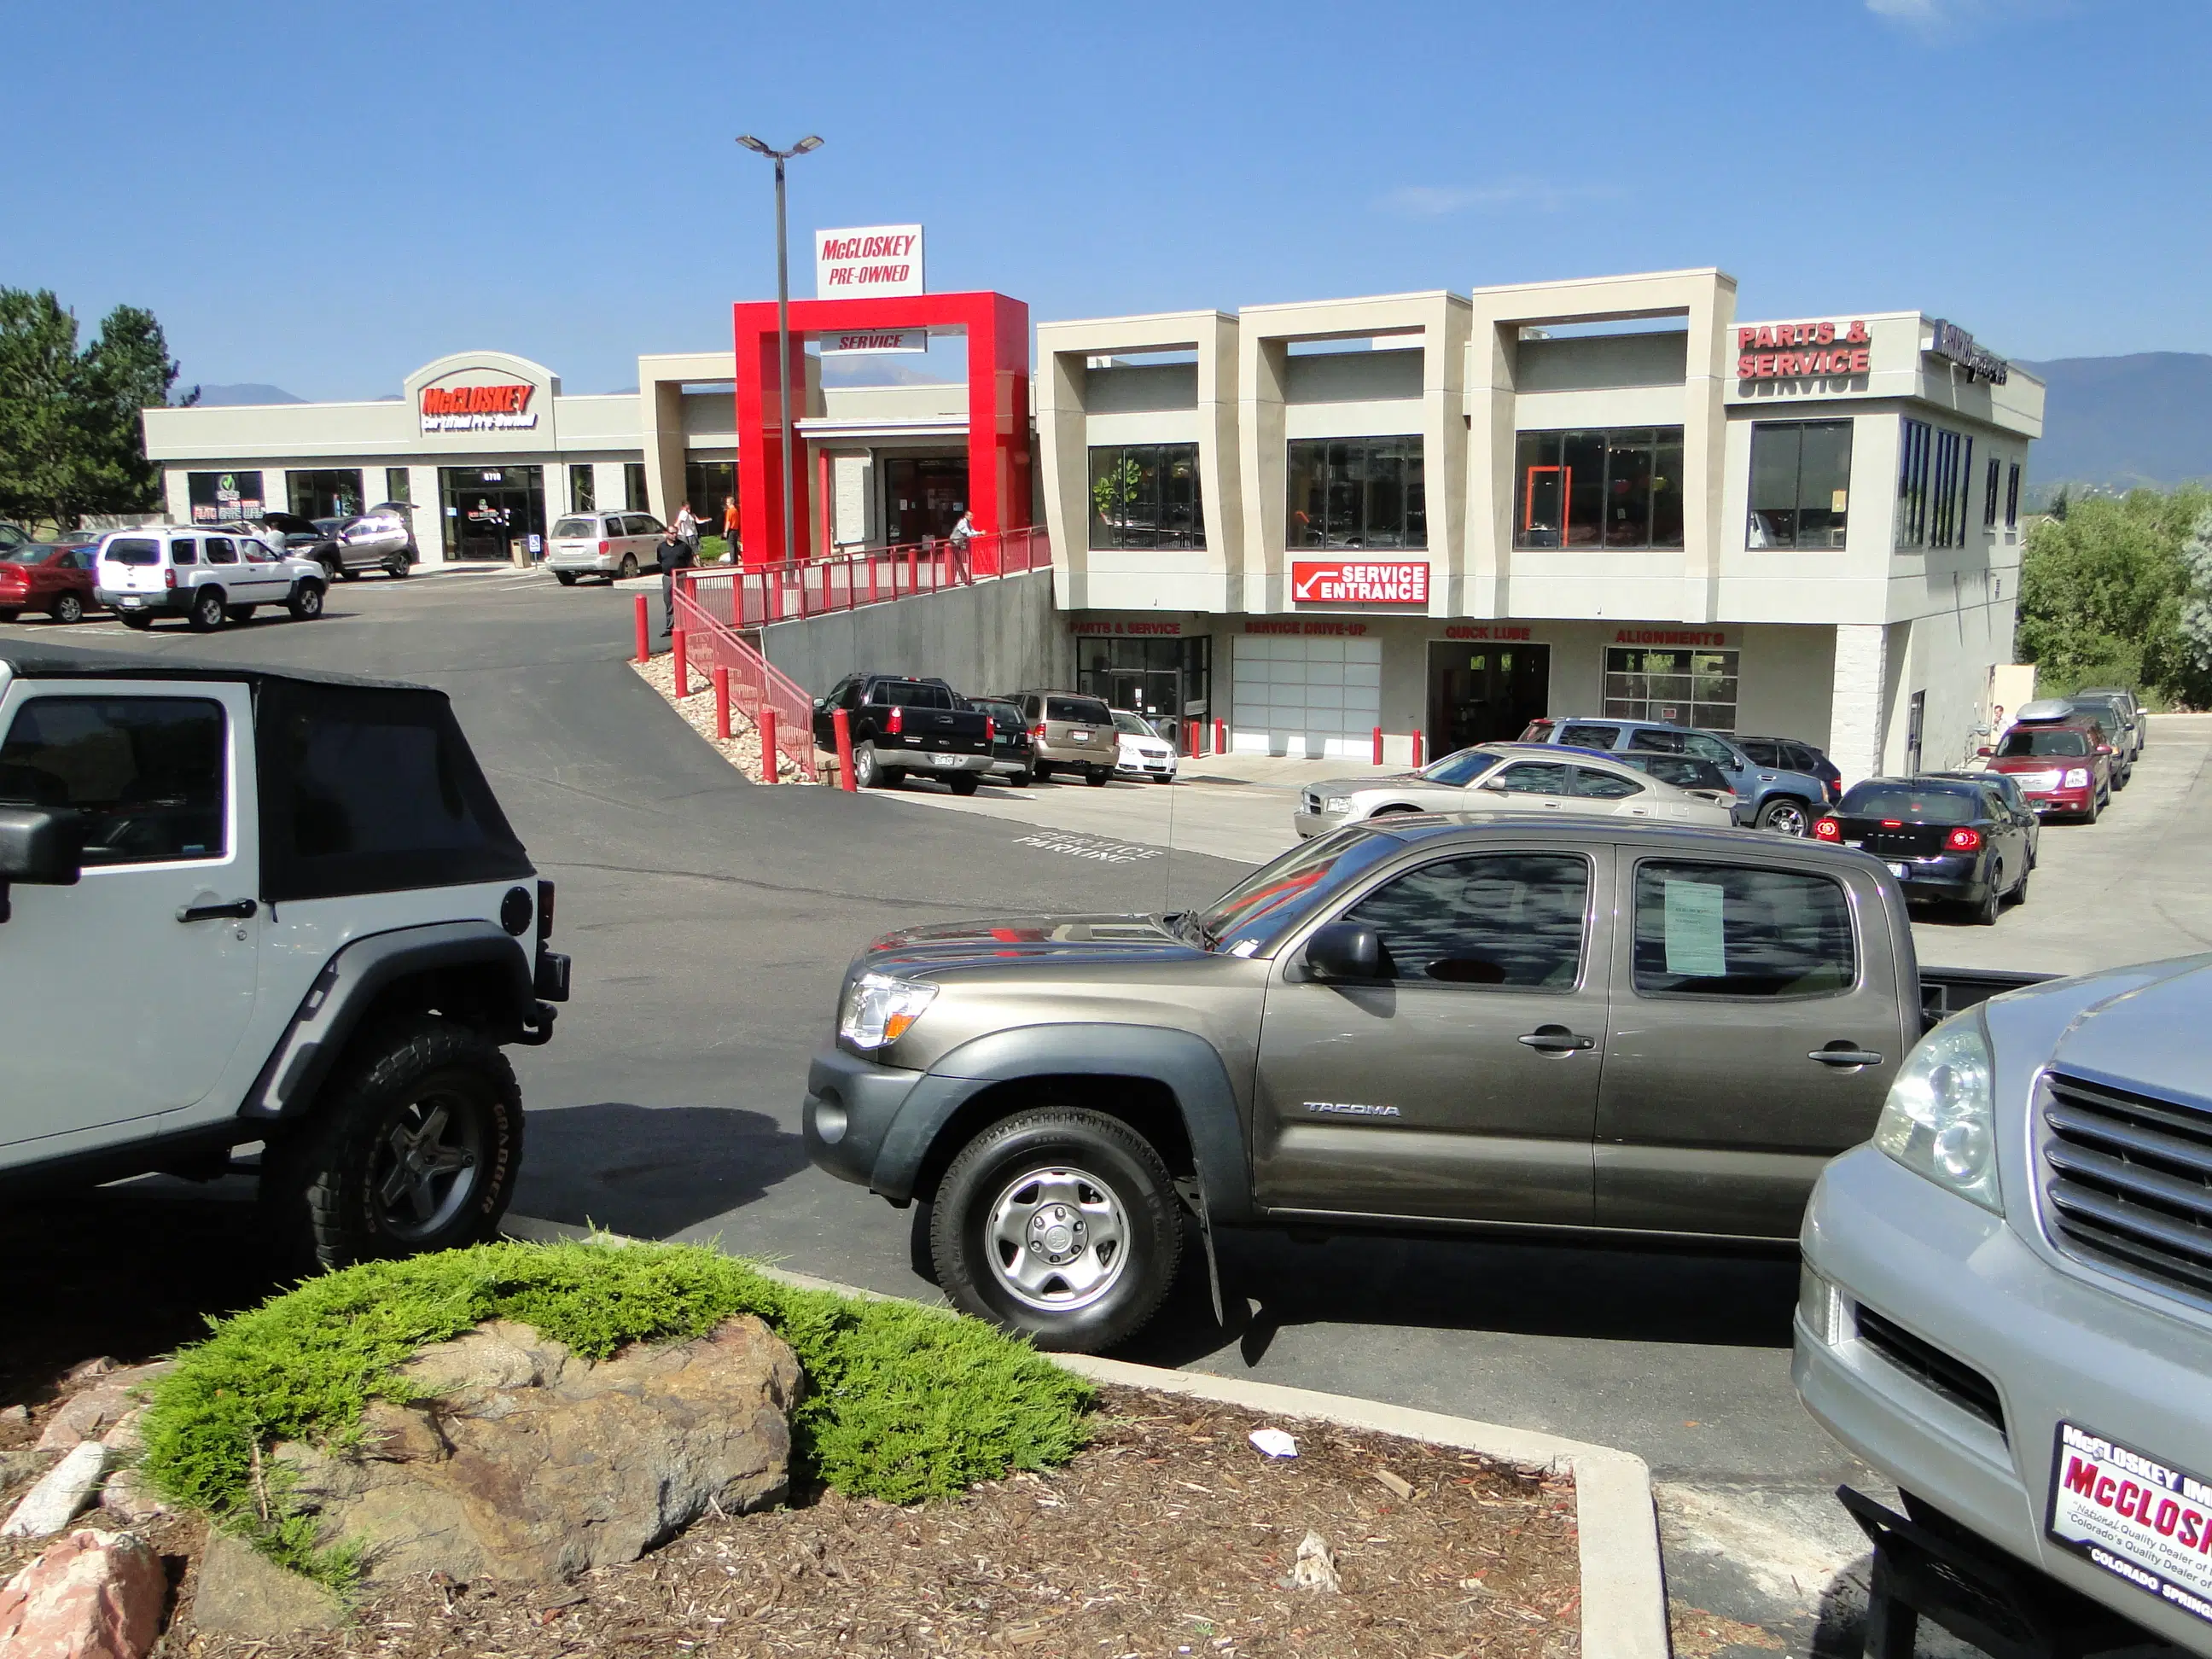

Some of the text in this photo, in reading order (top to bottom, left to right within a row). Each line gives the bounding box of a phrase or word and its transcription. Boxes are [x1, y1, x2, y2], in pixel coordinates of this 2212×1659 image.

[822, 235, 917, 260] McCLOSKEY
[829, 265, 910, 286] PRE-OWNED
[839, 335, 905, 351] SERVICE
[1738, 320, 1870, 349] PARTS &
[1737, 347, 1870, 379] SERVICE
[422, 385, 533, 415] McCLOSKEY
[1342, 565, 1425, 583] SERVICE
[1321, 582, 1424, 600] ENTRANCE
[1069, 622, 1181, 635] PARTS & SERVICE
[1245, 621, 1366, 635] SERVICE DRIVE-UP
[1446, 626, 1531, 640] QUICK LUBE
[1615, 630, 1725, 645] ALIGNMENTS
[1011, 837, 1137, 864] PARKING
[1032, 831, 1164, 859] SERVICE
[1303, 1102, 1401, 1117] TACOMA
[2063, 1424, 2212, 1509] McCLOSKEY IM
[2121, 1525, 2157, 1549] Quality
[2159, 1543, 2194, 1565] Dealer
[2091, 1548, 2158, 1590] COLORADO
[2125, 1541, 2162, 1565] Quality
[2163, 1559, 2198, 1581] Dealer
